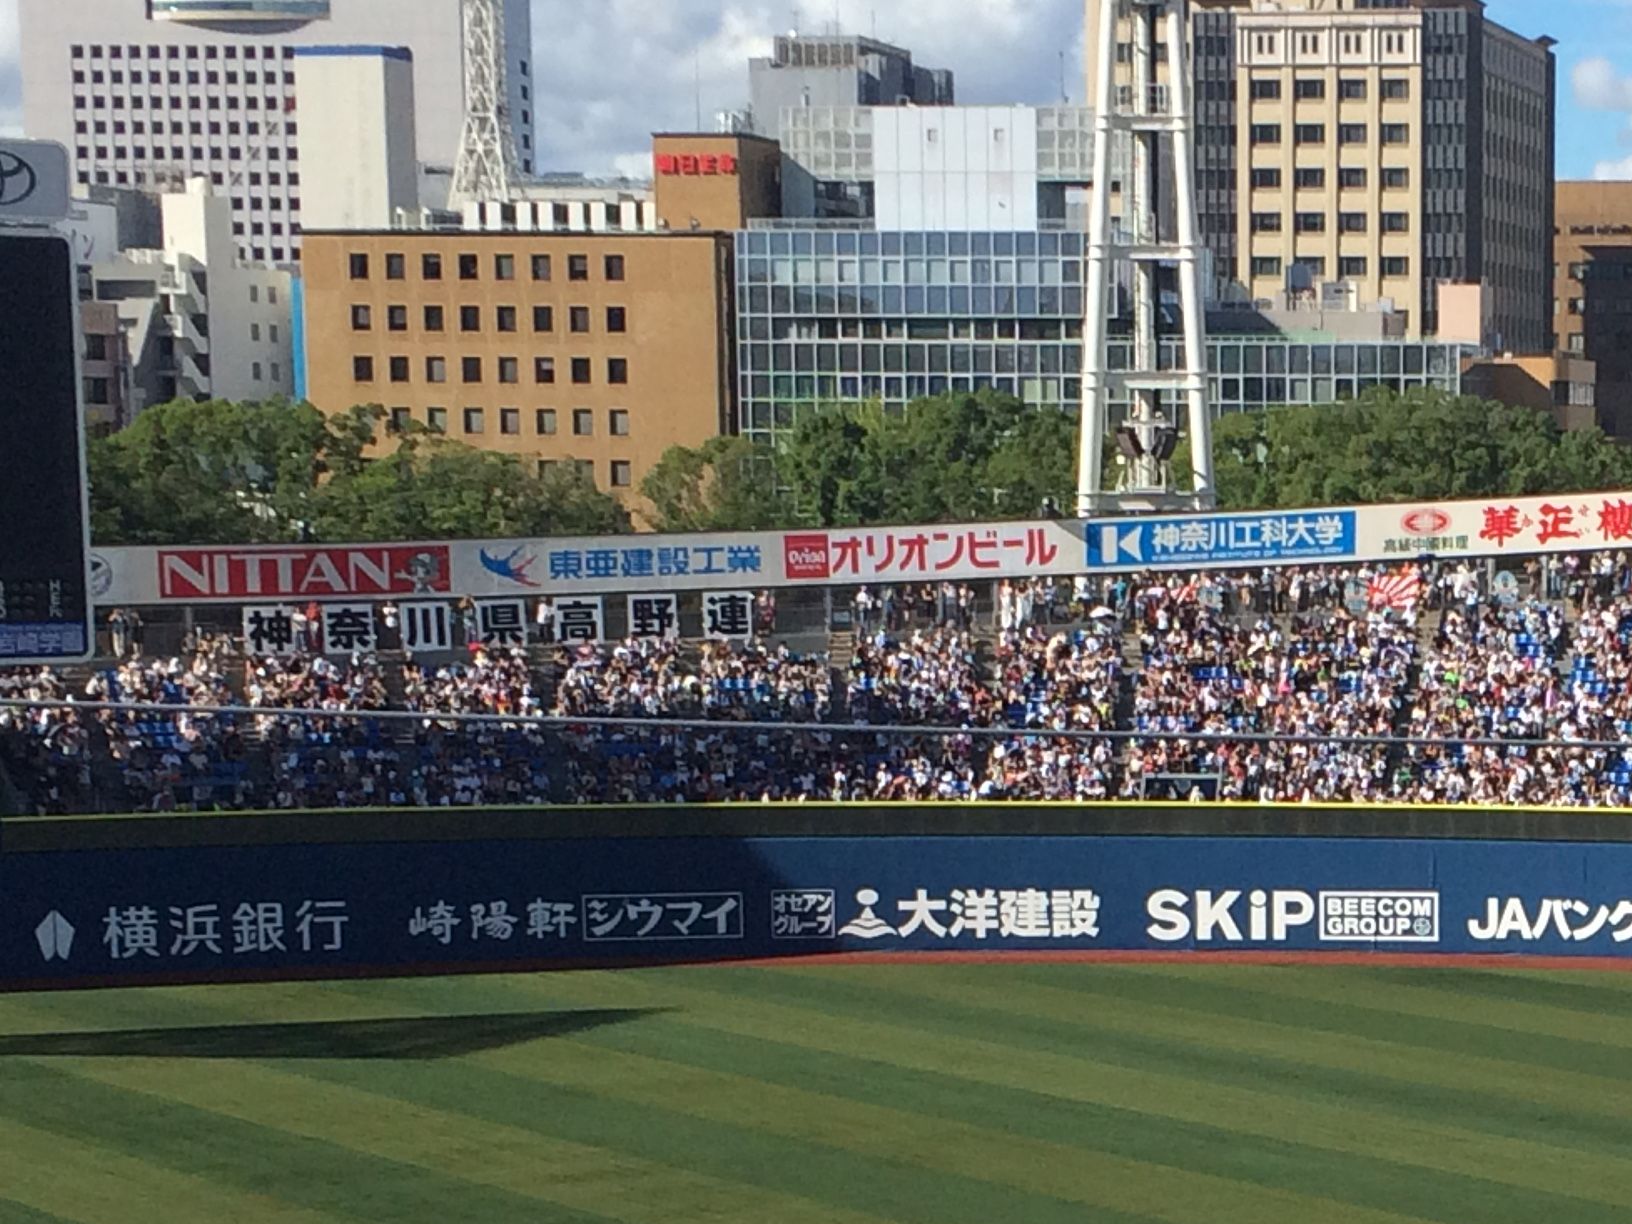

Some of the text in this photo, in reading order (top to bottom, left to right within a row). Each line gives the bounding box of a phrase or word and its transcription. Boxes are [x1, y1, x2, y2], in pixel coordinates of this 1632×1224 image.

[831, 528, 1058, 574] オリオンビール
[1151, 515, 1344, 553] 神奈川工科大学
[163, 551, 391, 596] NITTAN
[549, 545, 762, 580] 東亜建設工業
[408, 898, 578, 944] 崎陽軒
[588, 898, 738, 937] シウマイ
[773, 894, 832, 913] オセアン
[897, 889, 1100, 939] 大洋建設
[1326, 898, 1432, 917] BEECOM
[102, 899, 349, 959] 横浜銀行
[773, 913, 832, 935] グループ
[1326, 917, 1411, 935] GROUP
